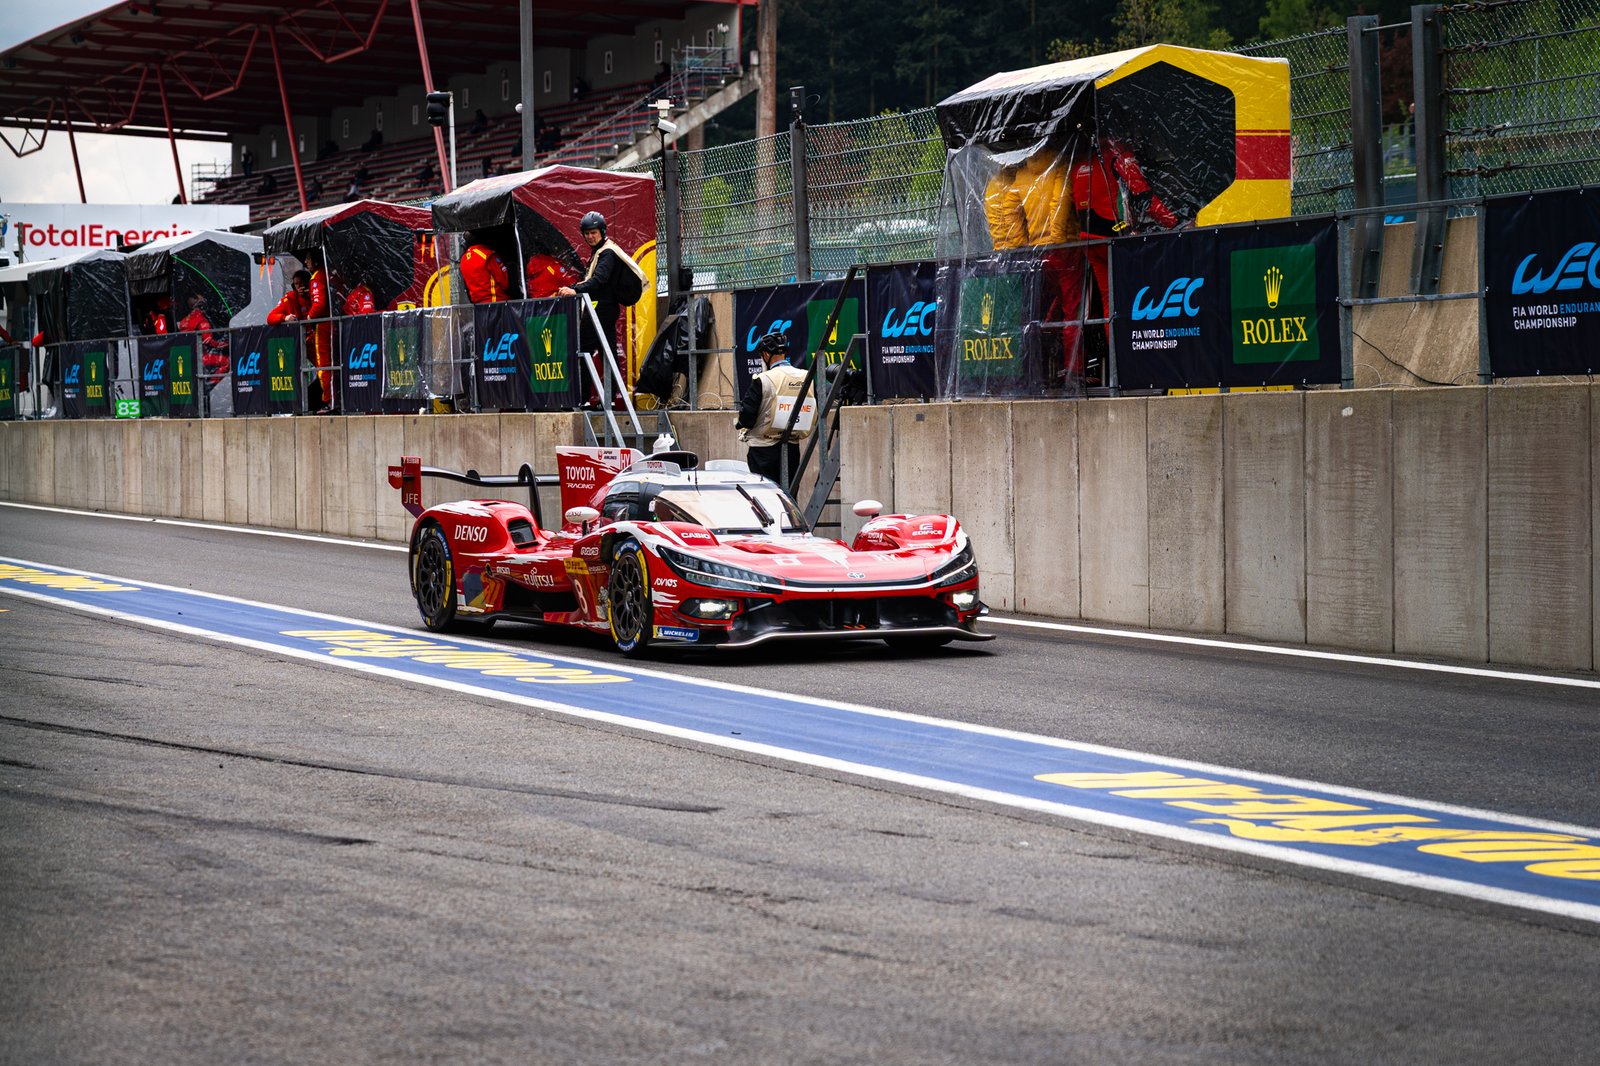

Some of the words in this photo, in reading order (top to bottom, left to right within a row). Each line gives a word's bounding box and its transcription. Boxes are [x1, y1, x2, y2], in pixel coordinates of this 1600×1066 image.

[1131, 277, 1205, 321] WEC
[1512, 306, 1527, 317] FIA
[1527, 304, 1559, 316] WORLD
[1559, 302, 1600, 314] ENDURAN
[881, 301, 937, 339] WEC
[1513, 316, 1577, 330] CHAMPIONSHIP
[1131, 330, 1142, 340] FIA
[1143, 328, 1165, 339] WORLD
[1165, 327, 1200, 337] ENDURANCE
[1241, 316, 1308, 345] ROLEX
[483, 332, 519, 362] WEC
[963, 336, 1014, 361] ROLEX
[1131, 339, 1178, 350] CHAMPIONSHIP
[349, 343, 378, 369] WEC
[237, 351, 261, 377] WEC
[534, 361, 564, 381] ROLEX
[271, 376, 294, 391] ROLEX
[390, 369, 415, 386] ROLEX
[172, 381, 192, 395] ROLEX
[118, 401, 140, 416] 83
[778, 403, 791, 412] PIT
[646, 461, 663, 469] TOYOTA
[565, 466, 596, 481] TOYOTA
[566, 482, 596, 490] RACING
[404, 493, 419, 505] JFE
[454, 524, 488, 543] DENSO
[680, 532, 711, 540] CASIO
[523, 573, 554, 589] FUJITSU
[574, 578, 588, 615] 8
[663, 629, 694, 638] MICHELIN
